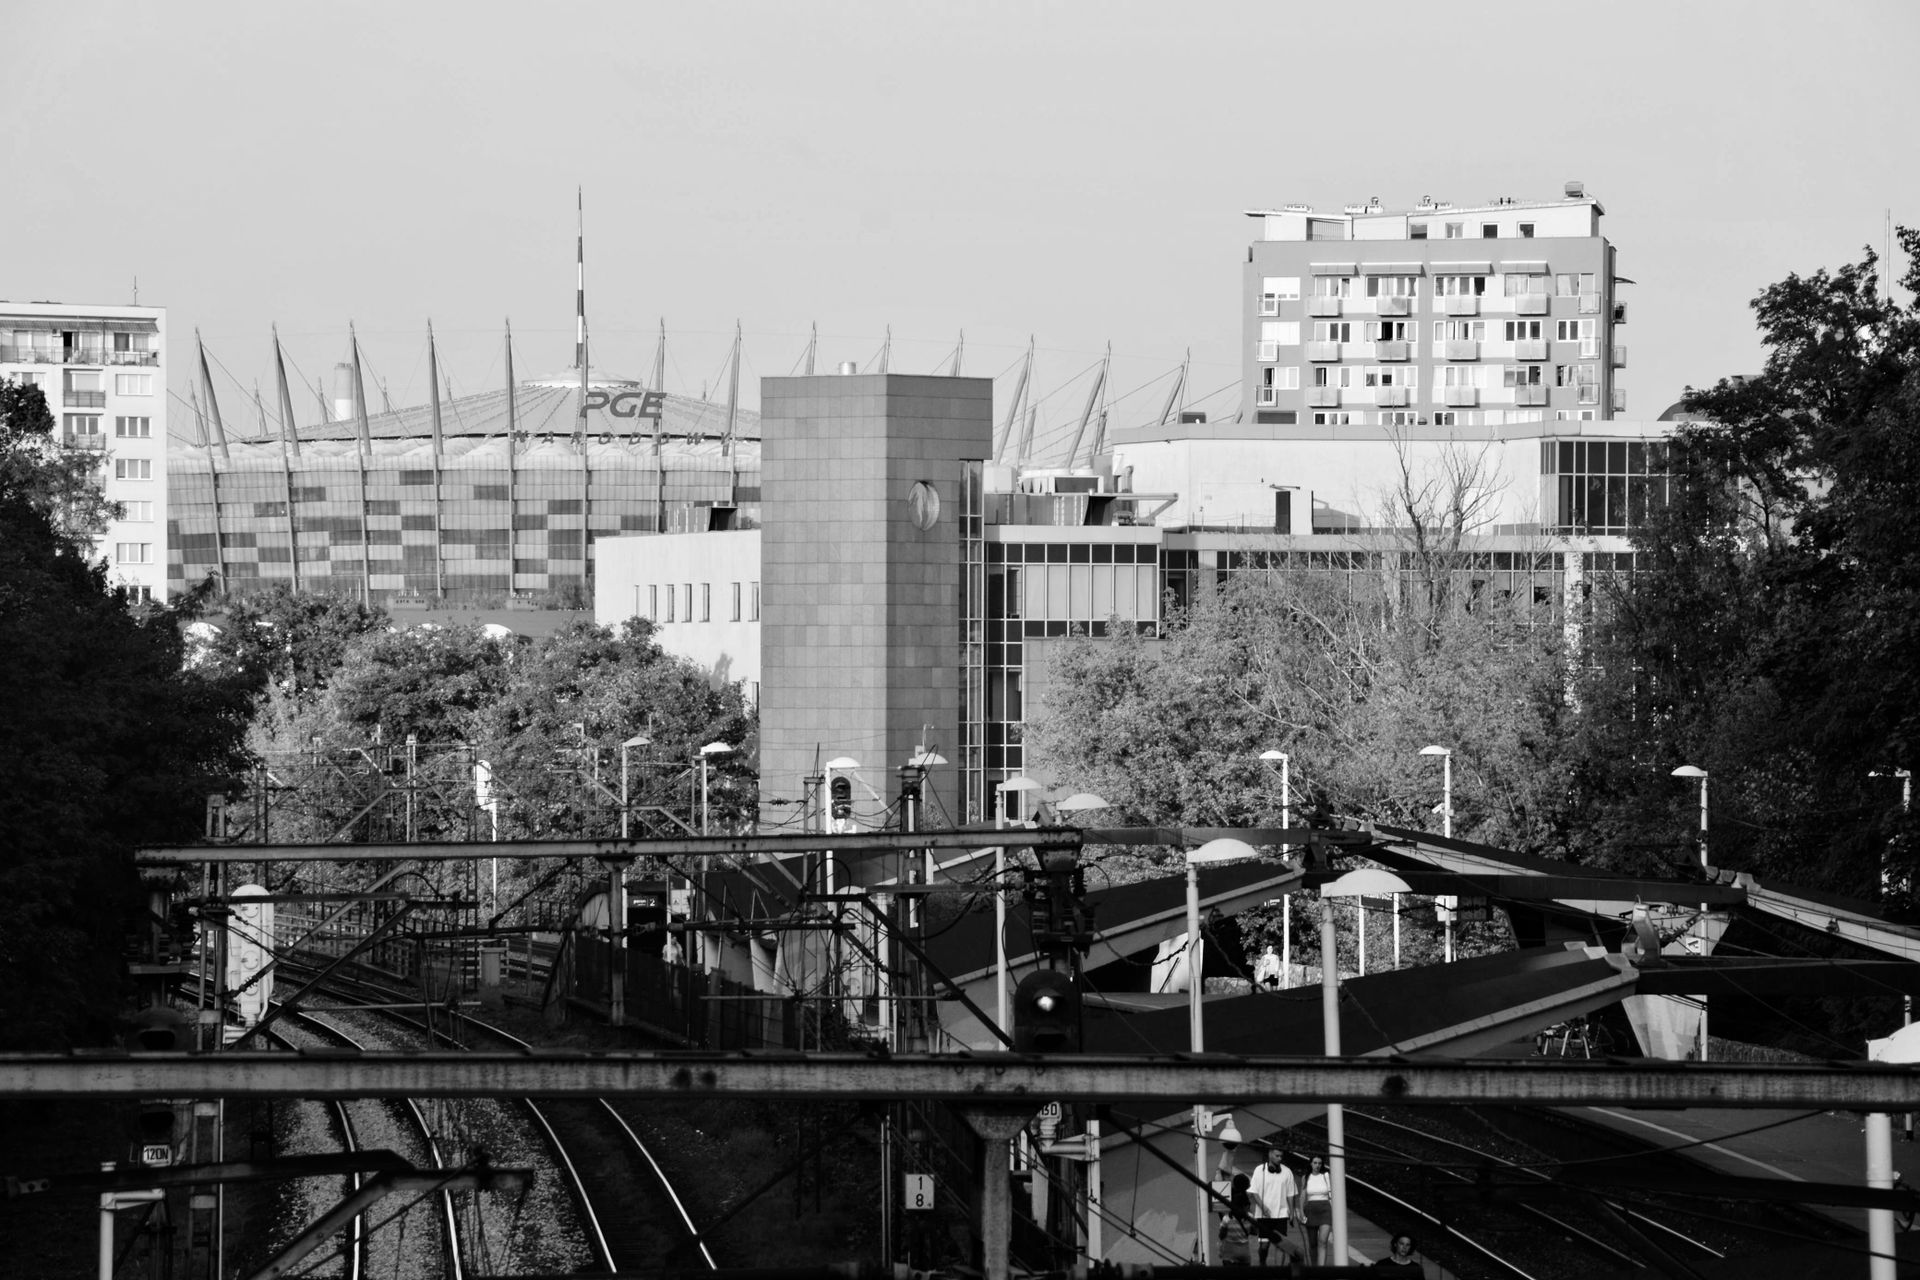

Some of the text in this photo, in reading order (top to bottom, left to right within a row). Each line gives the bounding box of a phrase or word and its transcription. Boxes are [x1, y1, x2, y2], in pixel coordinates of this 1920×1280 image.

[579, 391, 667, 418] PGE
[513, 430, 731, 446] NARODOWY
[649, 899, 656, 907] 2
[918, 1176, 923, 1190] 1
[916, 1193, 924, 1207] 8
